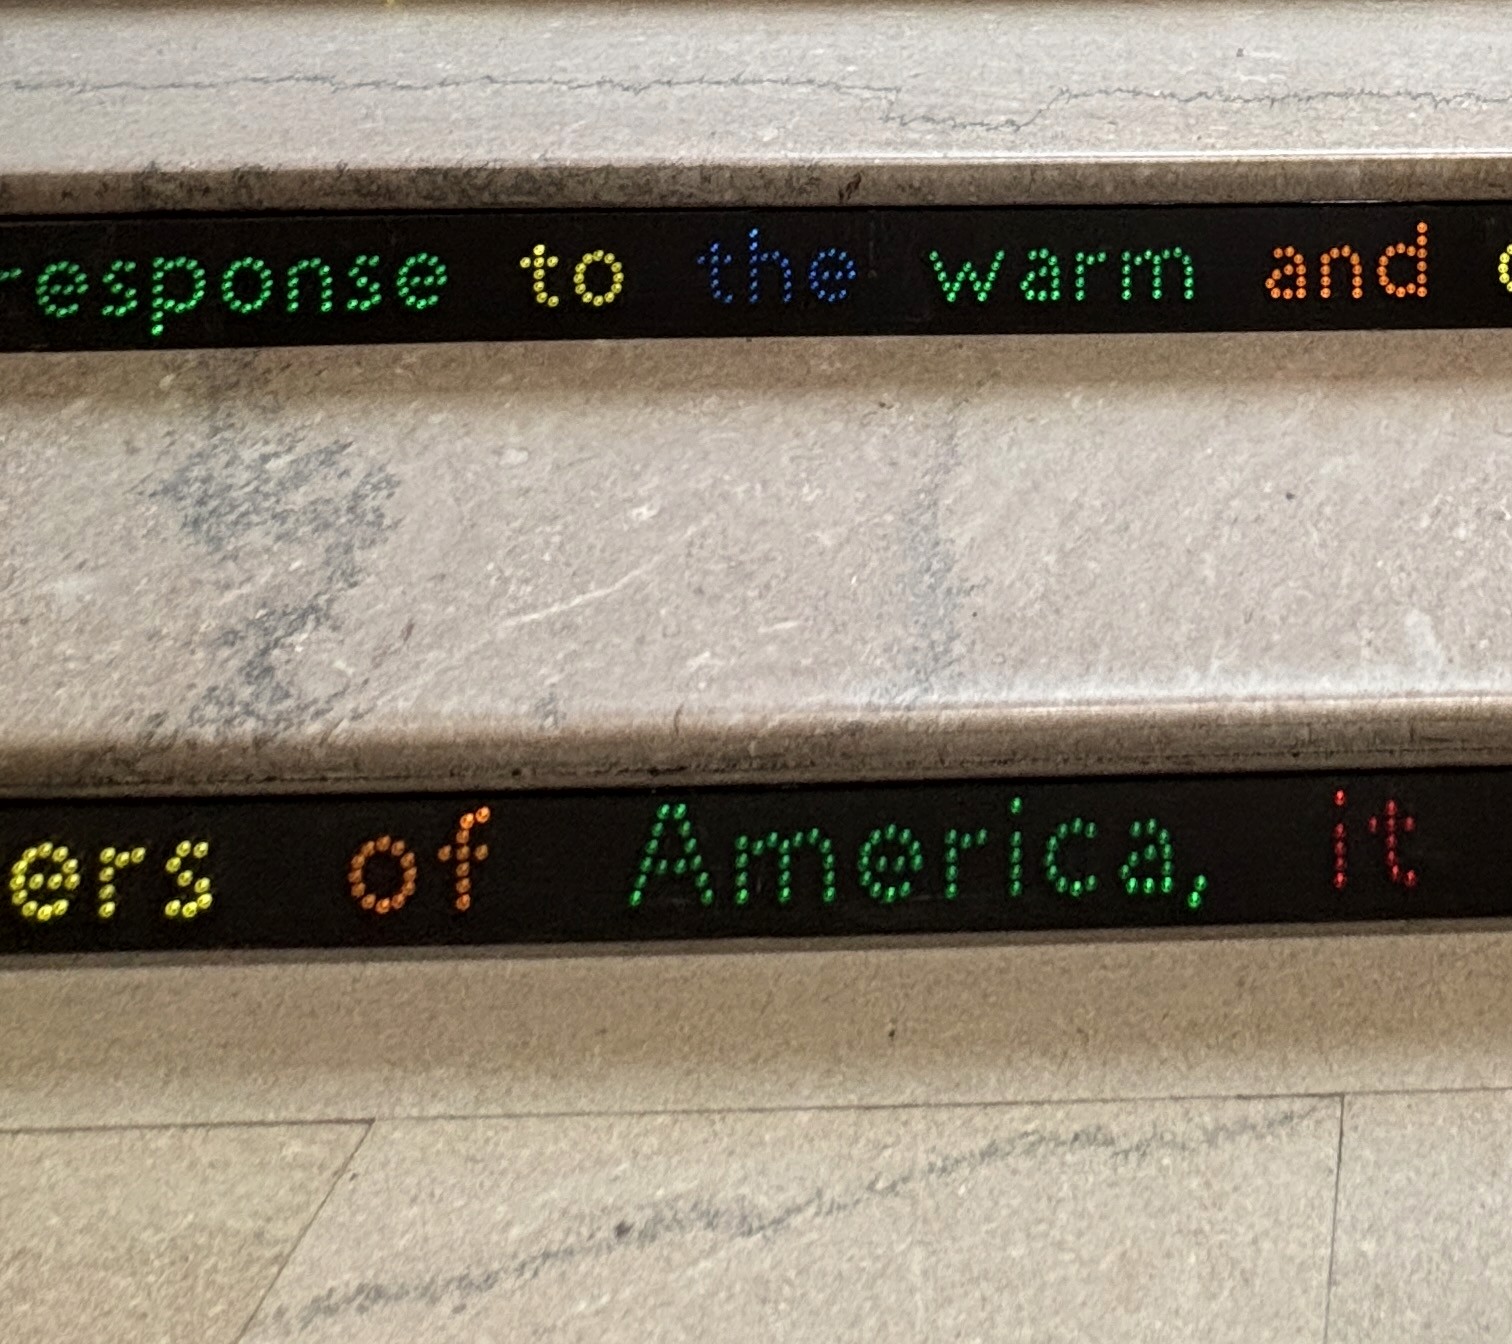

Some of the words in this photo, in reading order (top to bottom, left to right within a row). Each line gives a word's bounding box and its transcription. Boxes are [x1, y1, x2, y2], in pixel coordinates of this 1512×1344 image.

[519, 243, 625, 308] to
[697, 229, 858, 304] the
[930, 247, 1200, 301] warm
[1264, 220, 1429, 301] and
[7, 841, 213, 923] ers
[347, 805, 492, 916] of
[630, 798, 1207, 909] America,
[1332, 788, 1418, 891] it
